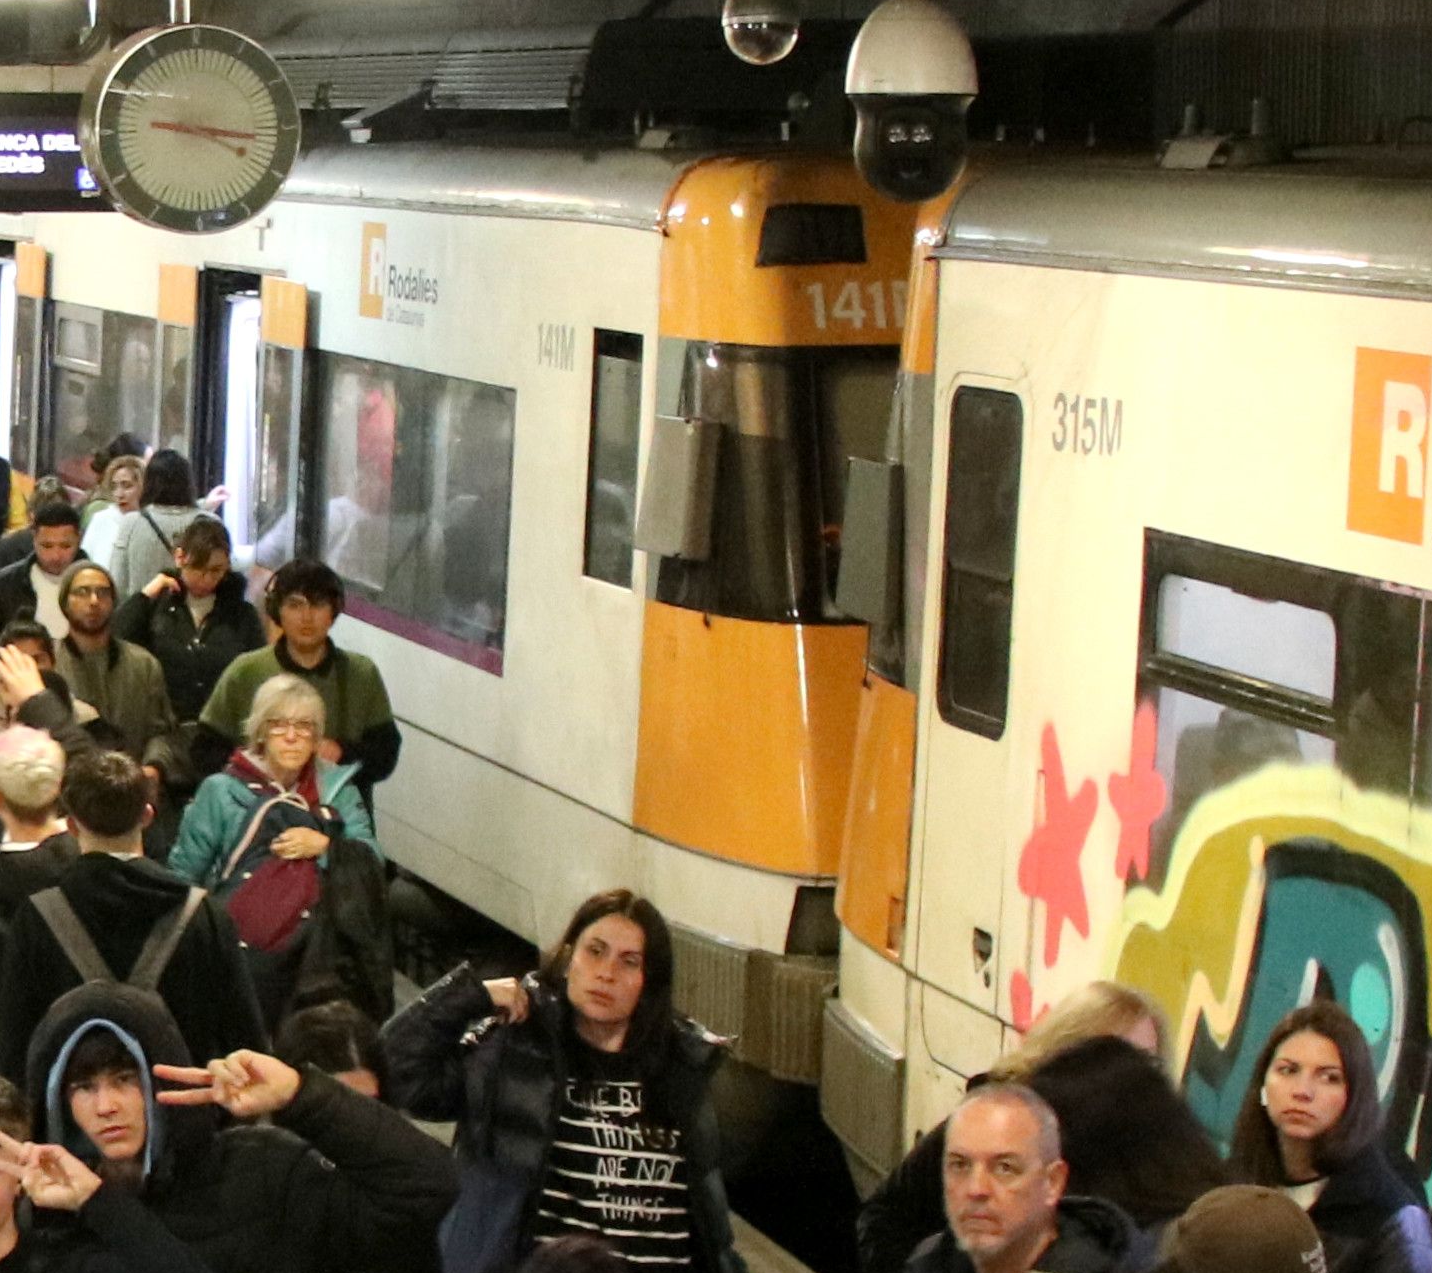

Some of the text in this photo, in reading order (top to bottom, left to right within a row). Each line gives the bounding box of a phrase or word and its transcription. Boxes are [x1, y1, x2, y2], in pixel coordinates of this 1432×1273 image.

[388, 264, 439, 305] Rodalies
[538, 323, 575, 372] 141M
[1051, 392, 1124, 457] 315M
